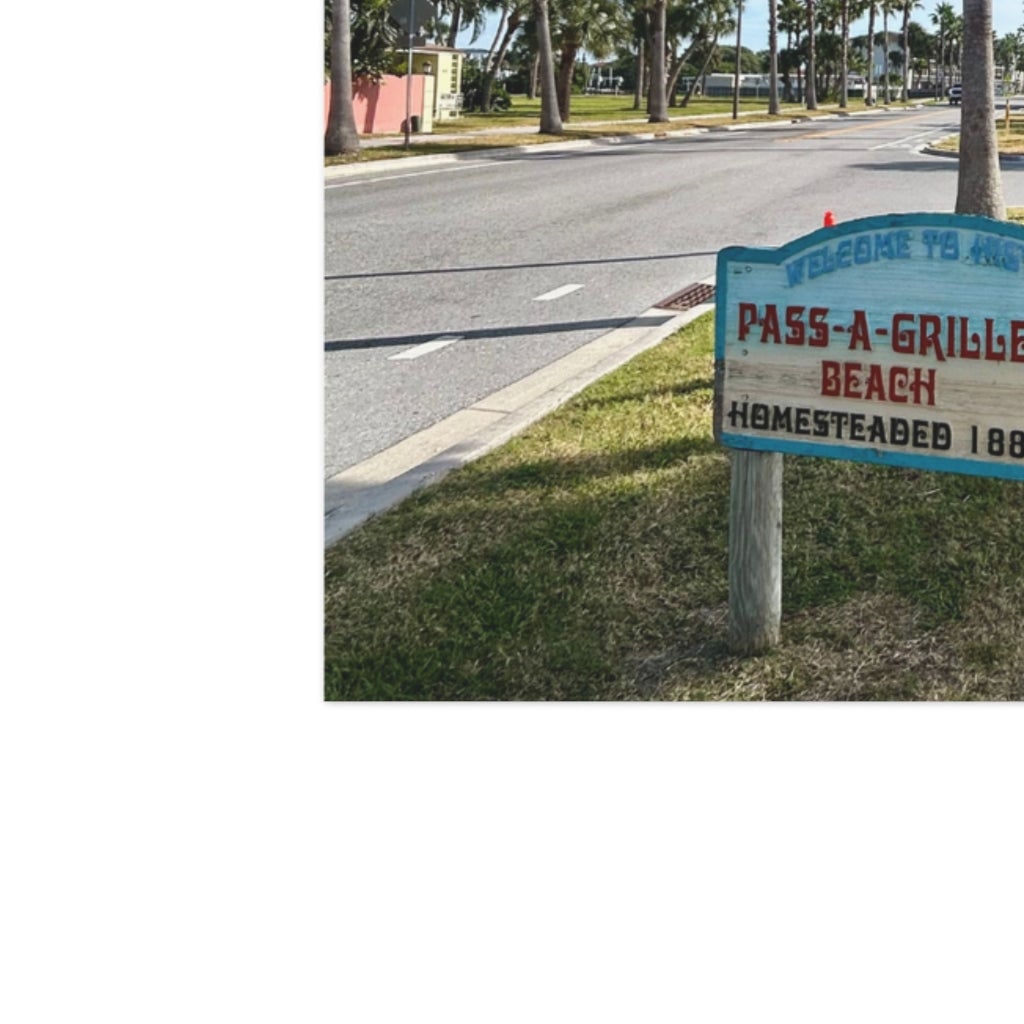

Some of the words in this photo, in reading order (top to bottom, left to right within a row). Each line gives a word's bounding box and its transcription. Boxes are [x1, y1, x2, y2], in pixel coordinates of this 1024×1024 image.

[785, 230, 912, 288] WELCOME
[922, 230, 960, 260] TO
[820, 359, 937, 406] BEACH
[727, 400, 952, 450] HOMESTEADED
